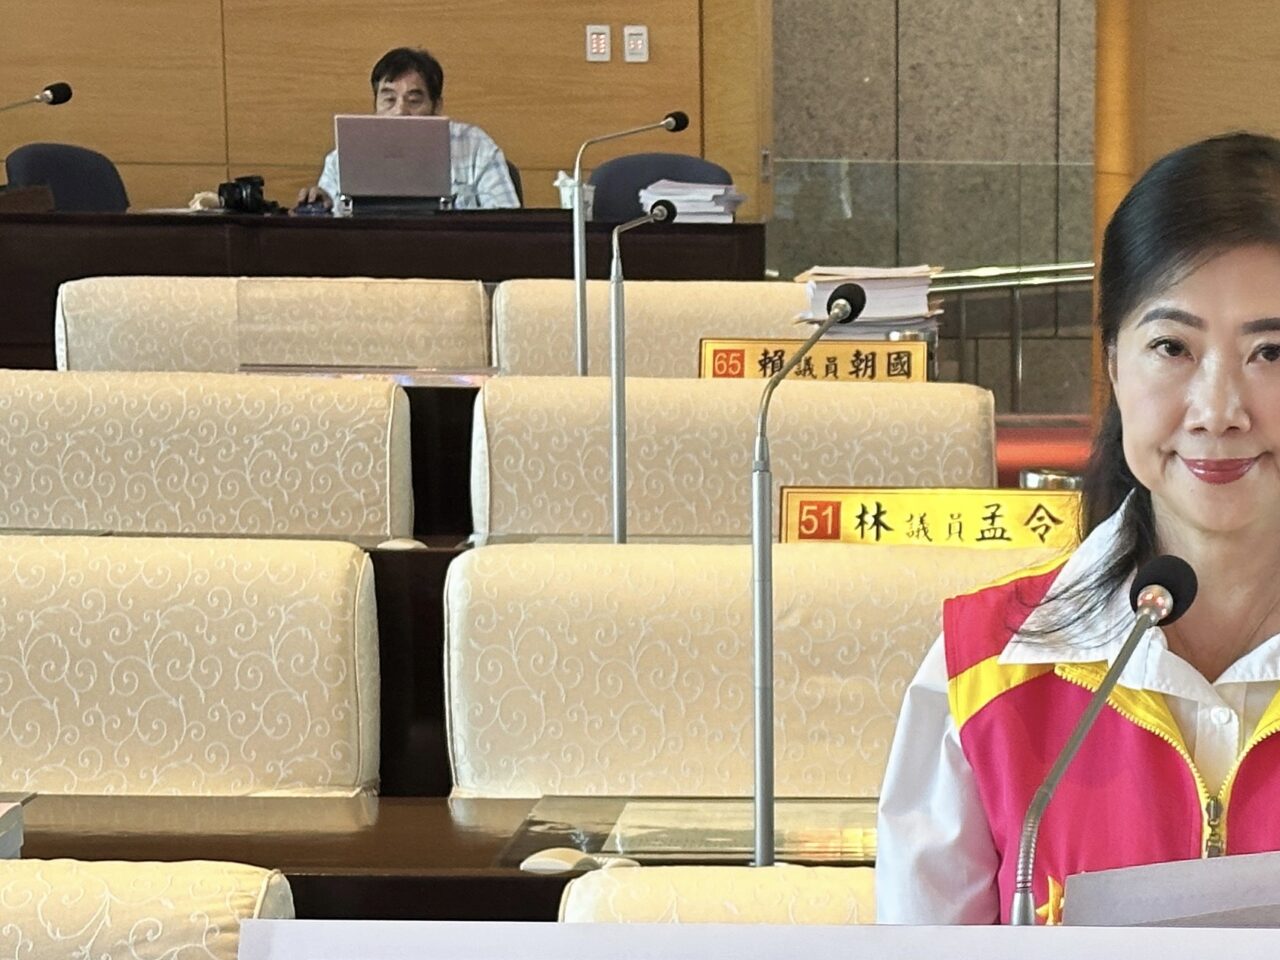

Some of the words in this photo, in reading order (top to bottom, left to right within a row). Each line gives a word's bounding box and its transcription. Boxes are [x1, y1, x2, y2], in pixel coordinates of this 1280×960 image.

[714, 352, 742, 376] 65
[757, 348, 913, 380] 賴議員朝國
[800, 504, 834, 535] 51
[854, 501, 1064, 543] 林議員孟令
